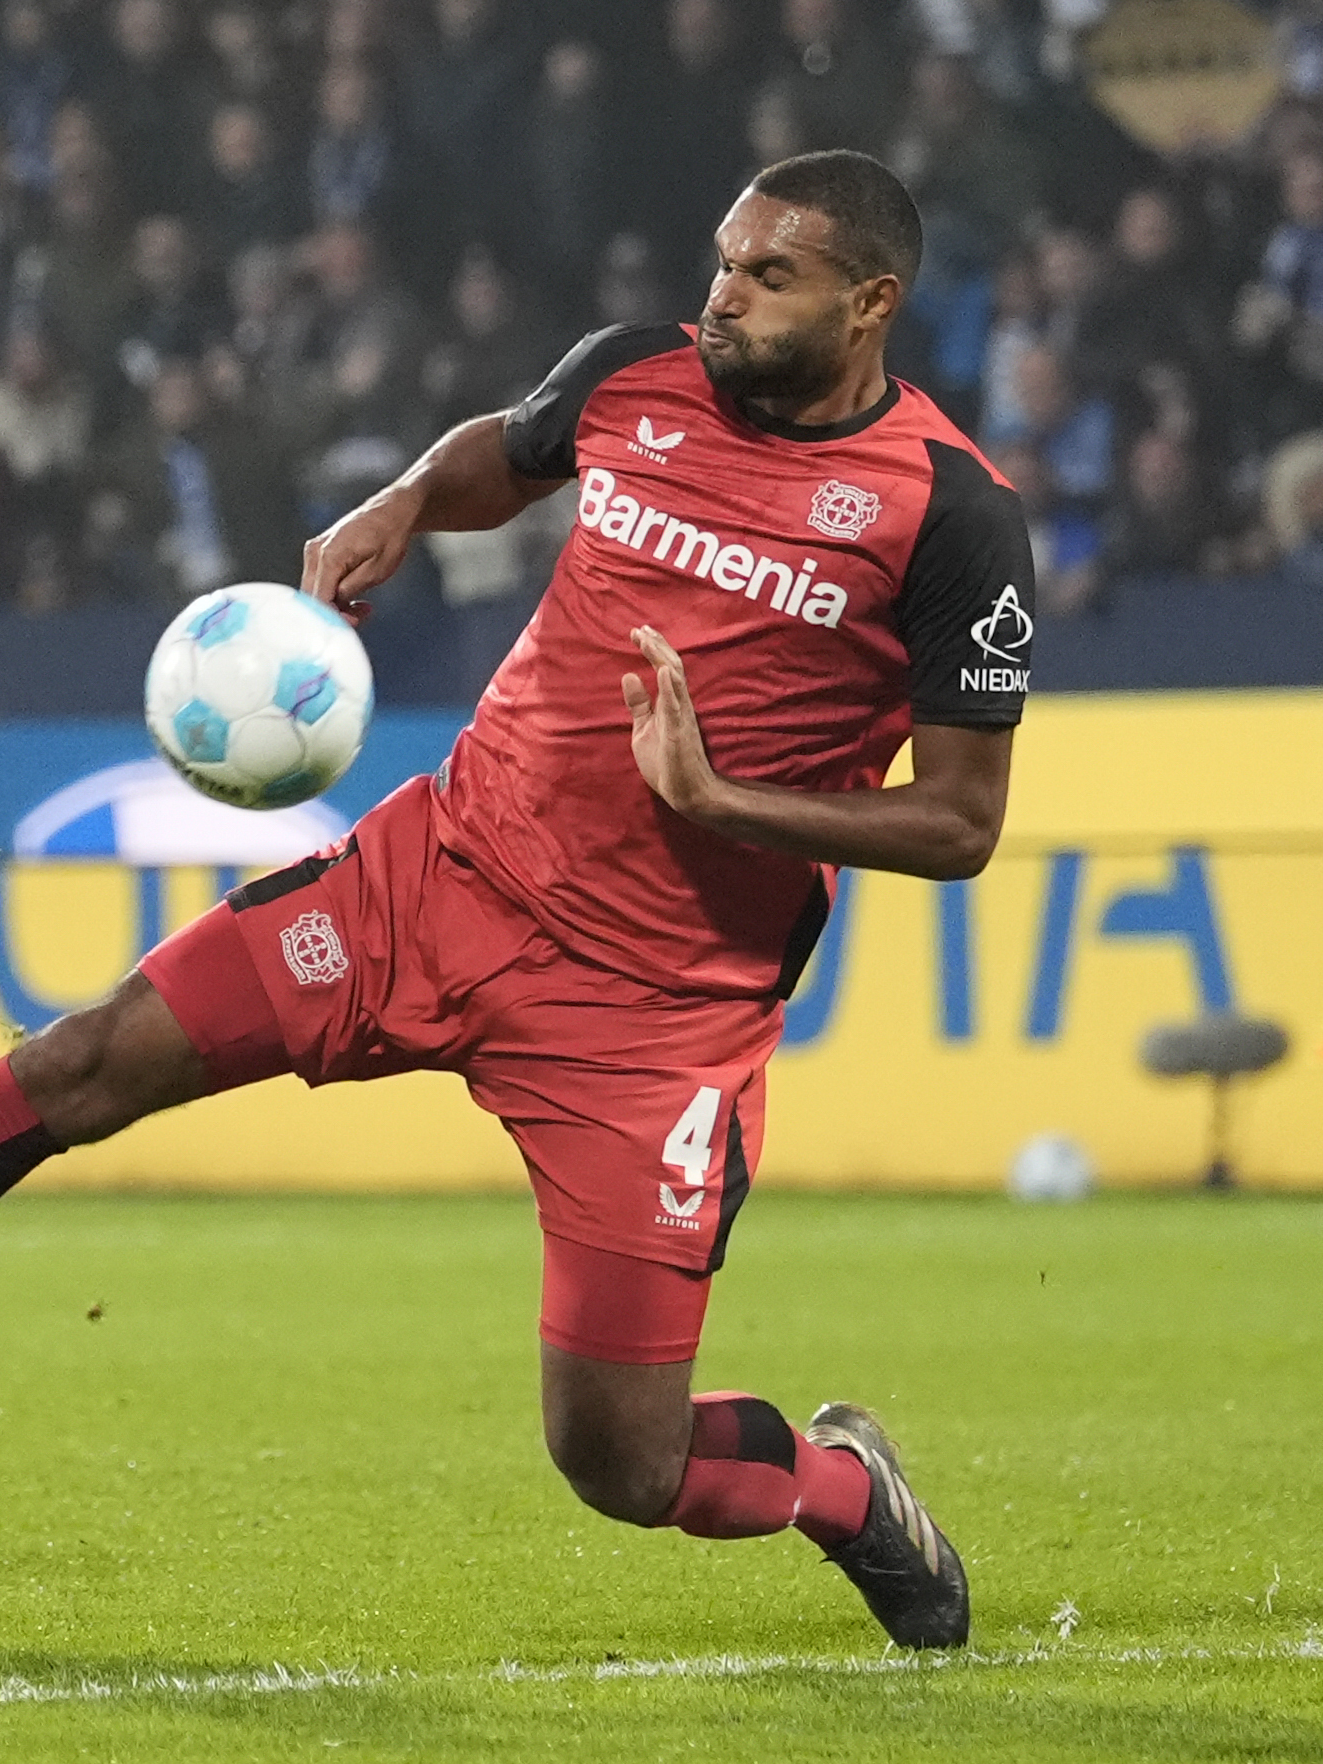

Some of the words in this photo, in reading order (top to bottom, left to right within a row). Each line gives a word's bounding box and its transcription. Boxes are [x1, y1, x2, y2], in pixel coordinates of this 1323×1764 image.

[579, 468, 848, 629] Barmenia
[960, 667, 1031, 693] NIEDAX
[662, 1086, 721, 1186] 4
